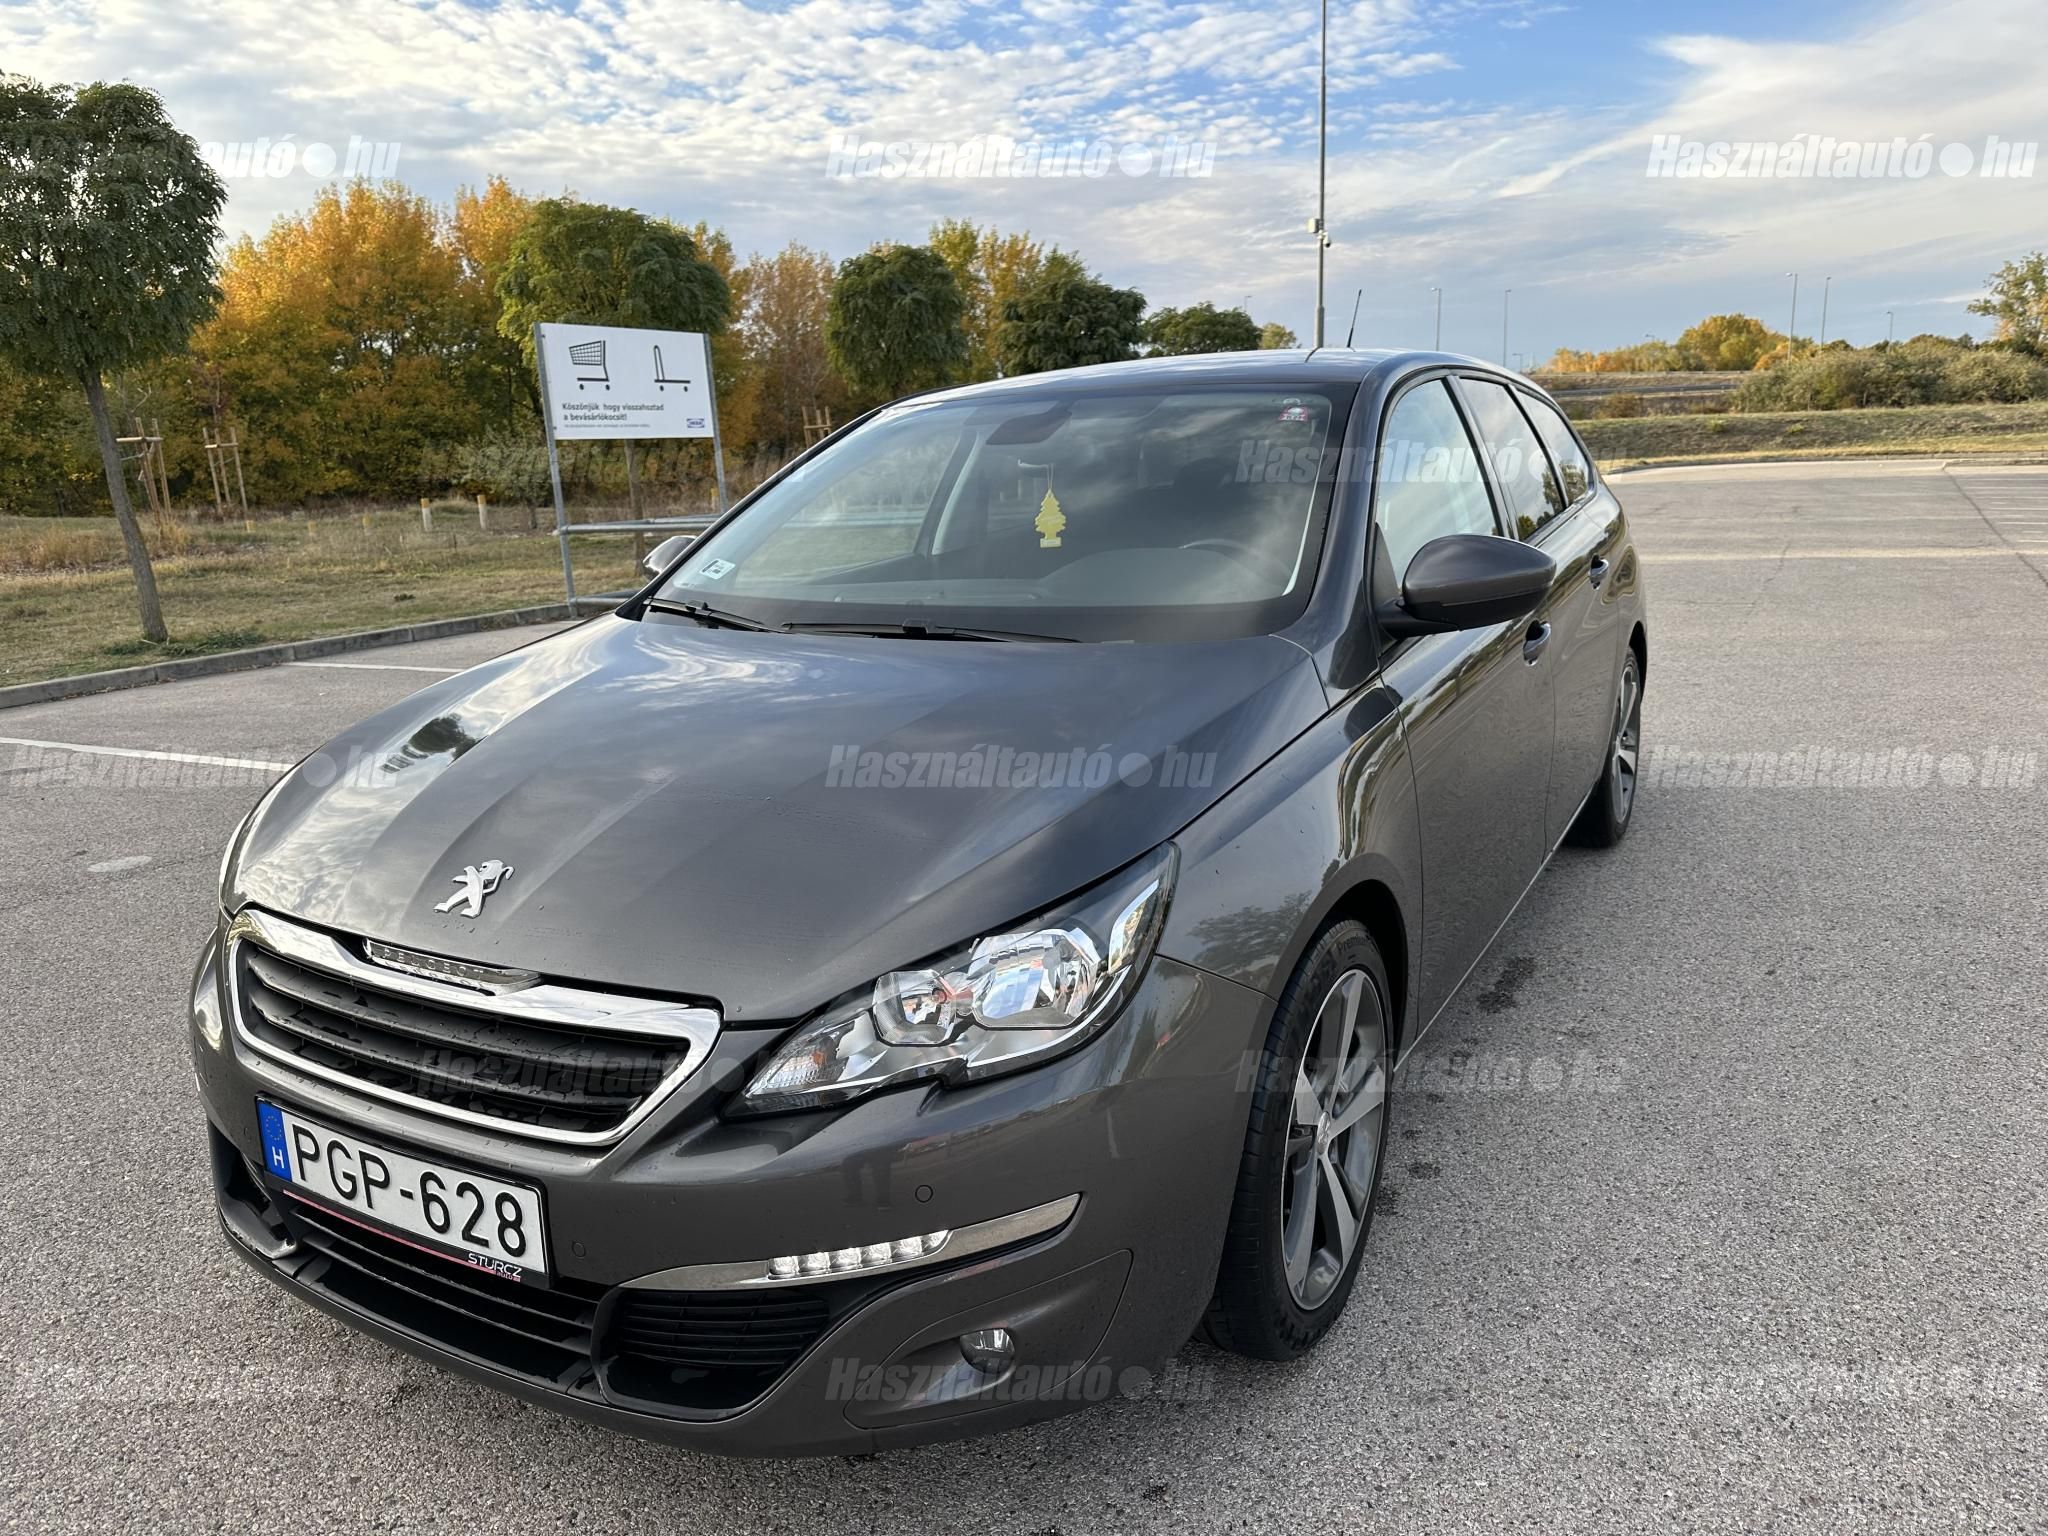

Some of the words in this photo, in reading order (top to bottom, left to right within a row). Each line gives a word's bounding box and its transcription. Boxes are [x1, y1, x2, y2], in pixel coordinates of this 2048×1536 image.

[272, 1146, 285, 1169] H
[292, 1123, 527, 1258] PGP-628
[468, 1253, 522, 1278] STURCZ
